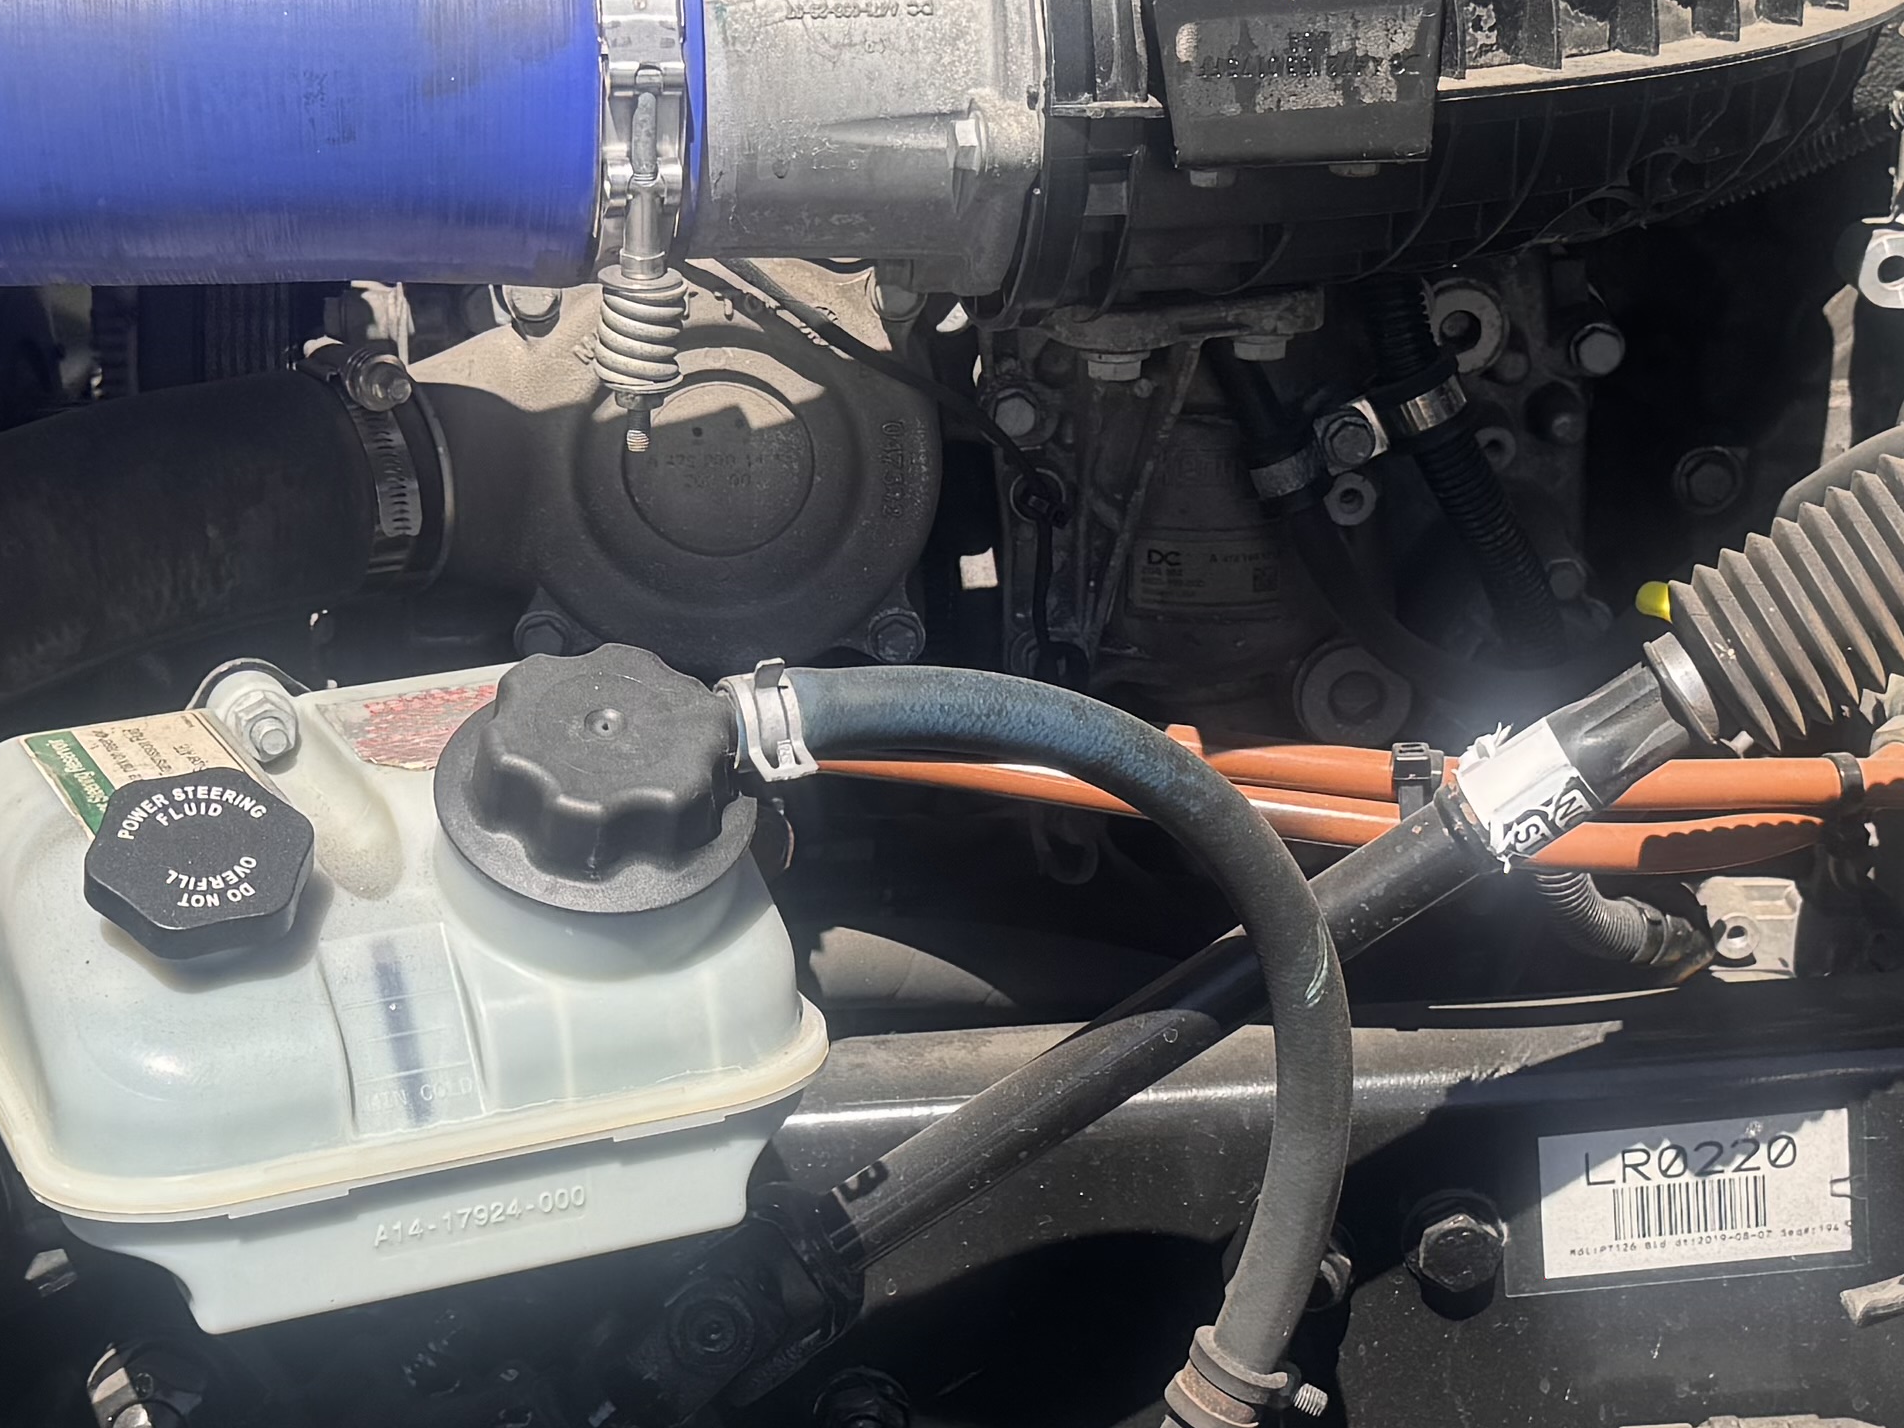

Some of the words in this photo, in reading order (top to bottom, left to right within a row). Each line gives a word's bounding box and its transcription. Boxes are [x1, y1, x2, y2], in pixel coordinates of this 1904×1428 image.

[117, 791, 170, 841] POWER
[173, 784, 268, 822] STEERING
[155, 801, 223, 826] FLUID
[164, 854, 258, 892] OVERFILL
[176, 893, 220, 908] NOT
[225, 882, 256, 904] DO
[1585, 1135, 1797, 1187] LR0220
[373, 1186, 587, 1249] A14-17924-000
